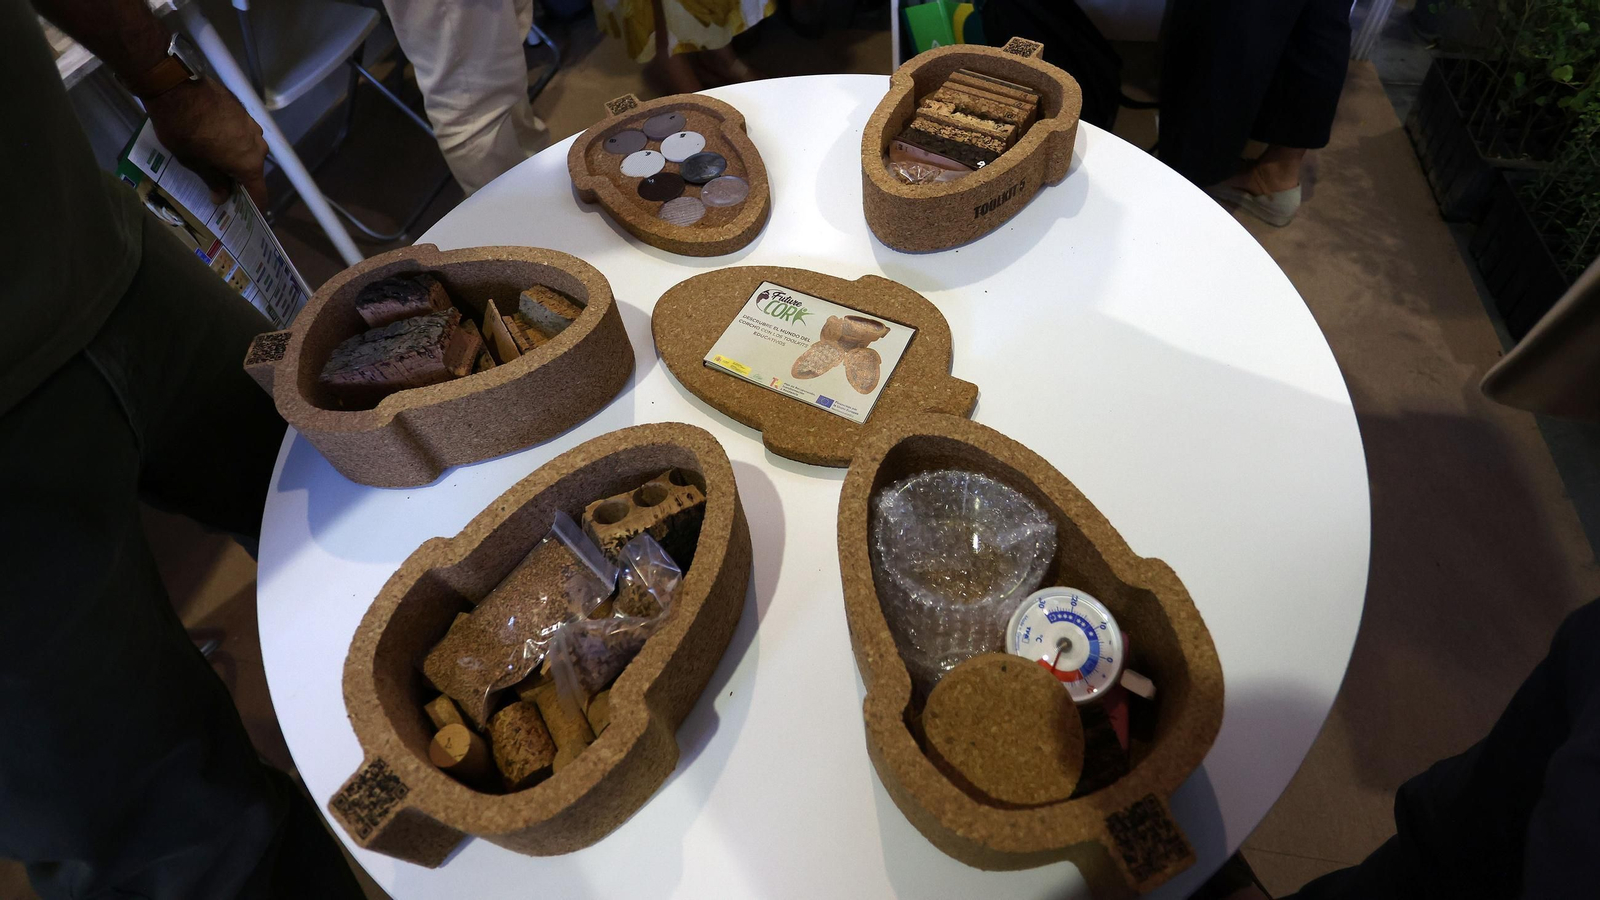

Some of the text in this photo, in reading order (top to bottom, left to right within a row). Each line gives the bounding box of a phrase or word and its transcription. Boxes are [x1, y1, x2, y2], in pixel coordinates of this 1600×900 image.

[973, 176, 1027, 219] TOOLKIT 5
[771, 290, 803, 307] Future
[738, 319, 761, 331] CORCHO
[760, 327, 772, 335] CON
[783, 336, 810, 348] TOOLKITS
[753, 331, 787, 347] EDUCATIVOS
[772, 324, 780, 332] EL
[779, 328, 800, 339] MUNDO
[800, 335, 811, 343] DEL
[1070, 594, 1079, 607] 20
[1099, 621, 1107, 630] 10
